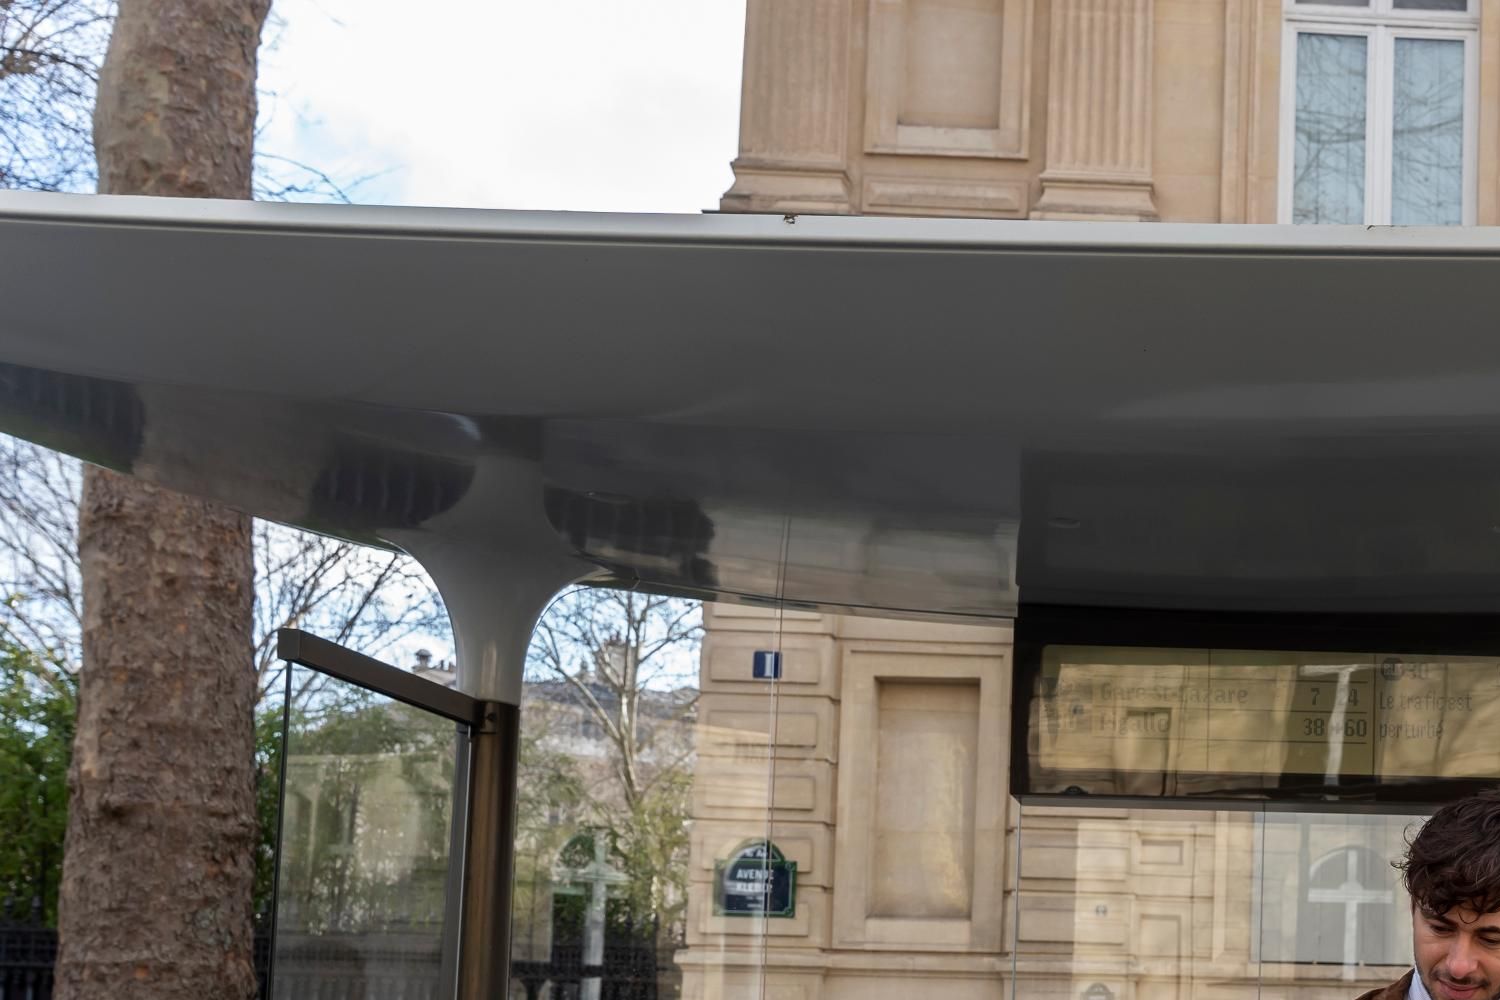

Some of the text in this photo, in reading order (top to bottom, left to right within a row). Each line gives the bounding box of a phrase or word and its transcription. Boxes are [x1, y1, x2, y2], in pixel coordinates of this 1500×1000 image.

[1101, 682, 1145, 701] Gare
[1310, 688, 1320, 706] 7
[1379, 691, 1395, 711] Le
[1303, 718, 1325, 737] 38
